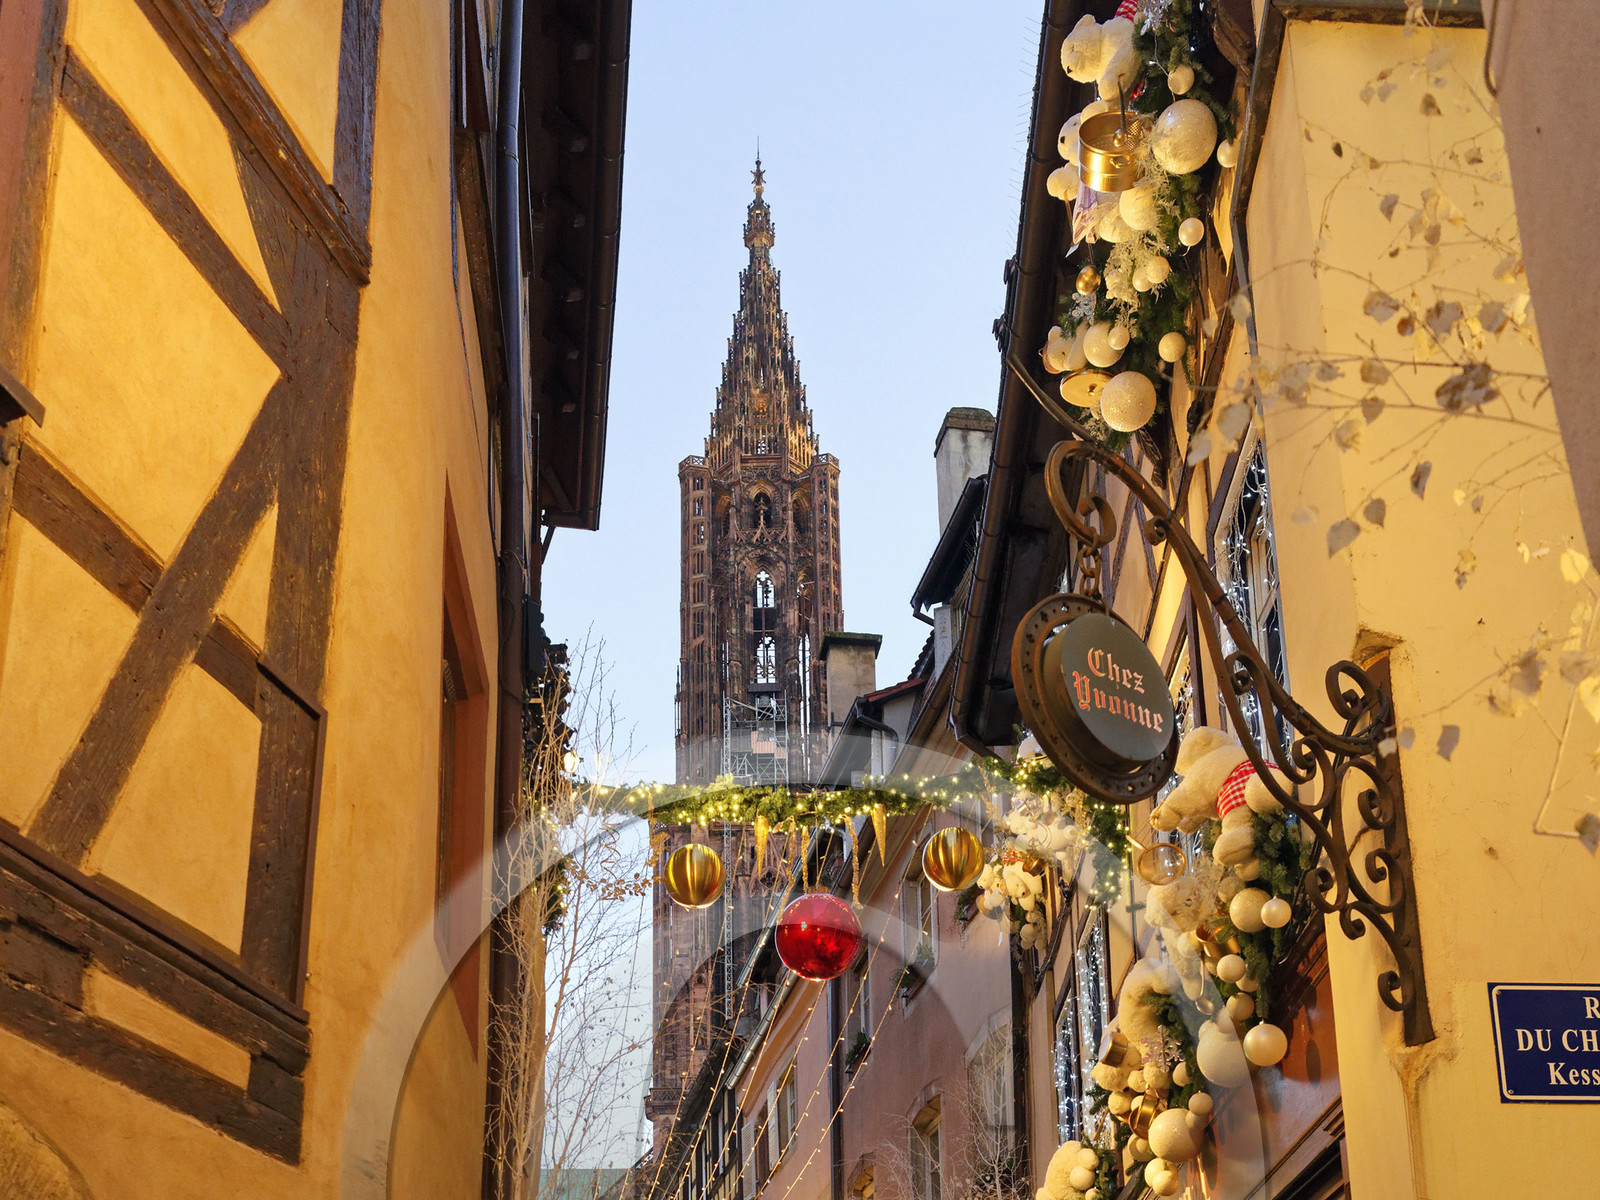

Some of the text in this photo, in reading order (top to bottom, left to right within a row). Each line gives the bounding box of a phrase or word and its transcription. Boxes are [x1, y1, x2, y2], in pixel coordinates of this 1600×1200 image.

[1088, 647, 1145, 694] Chez
[1072, 671, 1164, 733] Yvonne
[1515, 1029, 1600, 1052] DU CH
[1547, 1062, 1600, 1086] Kess
